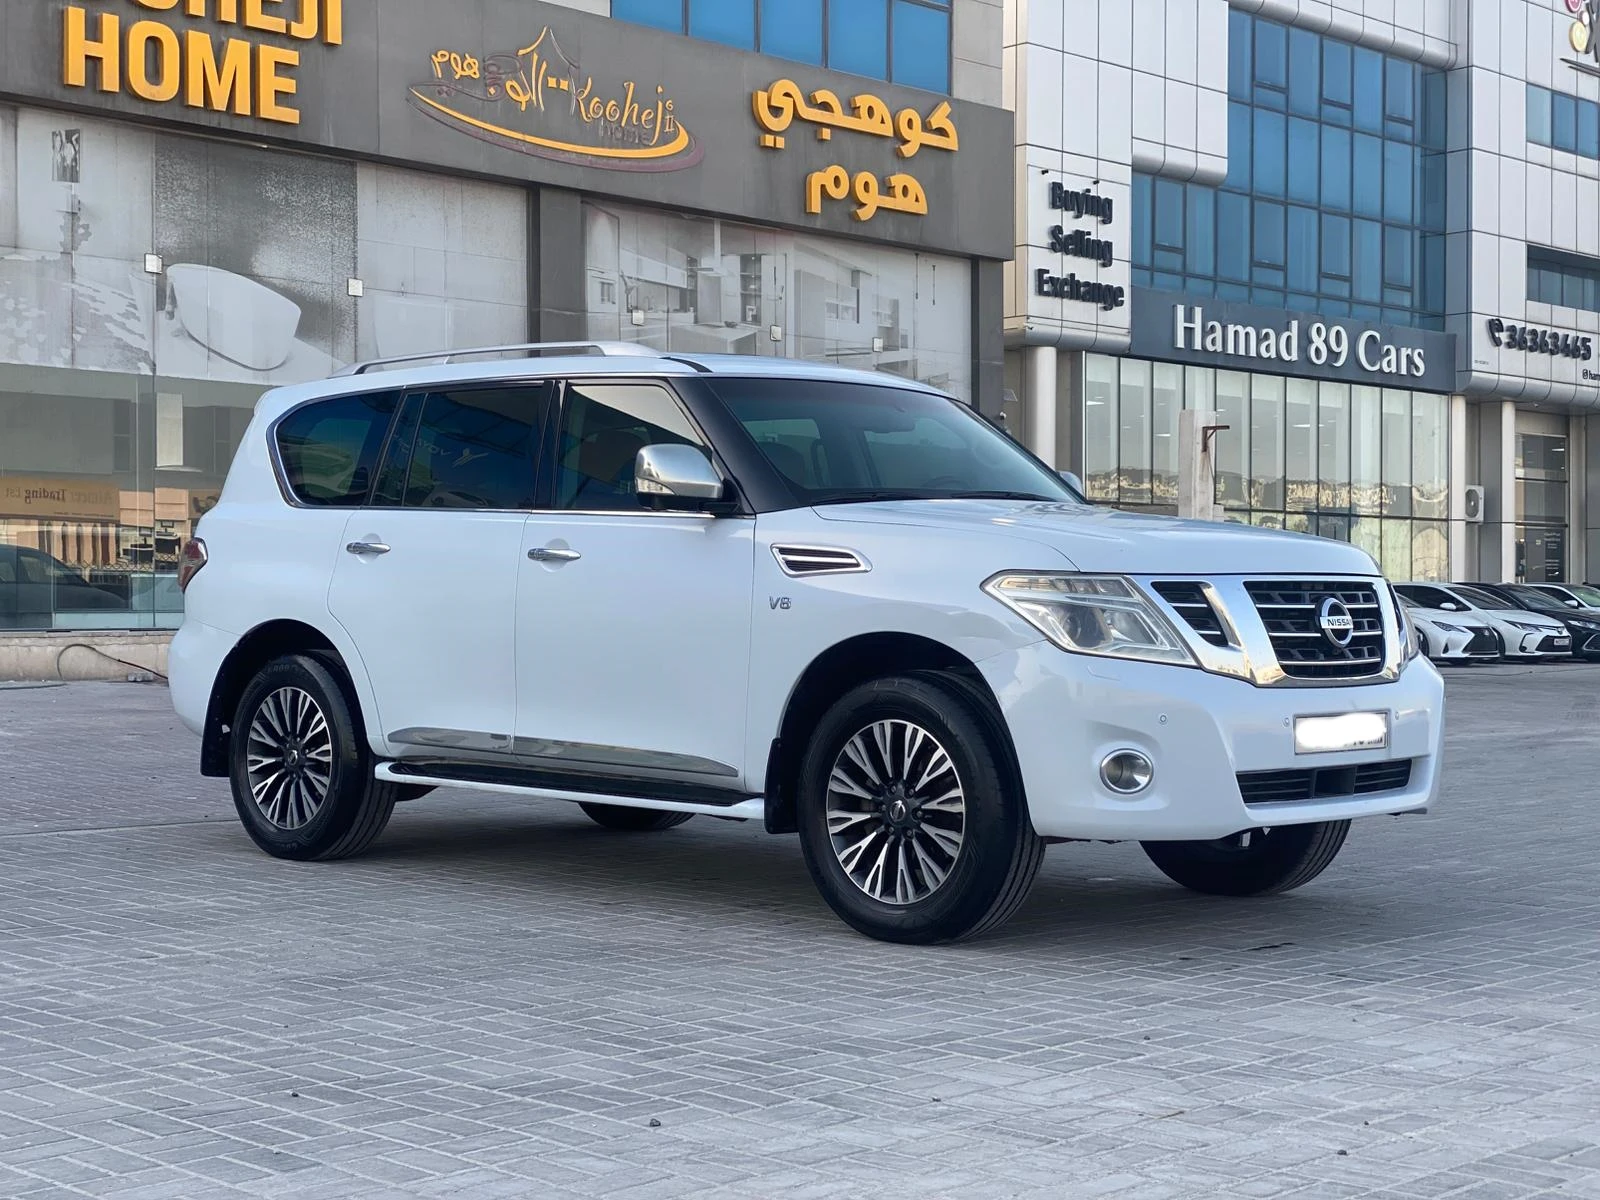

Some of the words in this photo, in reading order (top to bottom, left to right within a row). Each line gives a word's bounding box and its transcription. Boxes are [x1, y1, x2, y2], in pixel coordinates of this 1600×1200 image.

[63, 6, 300, 125] HOME
[752, 79, 959, 158] كوهجي
[806, 165, 928, 221] هوم
[1050, 181, 1113, 225] Buying
[1050, 225, 1113, 267] Selling
[1035, 268, 1125, 311] Exchange
[1173, 303, 1299, 362] Hamad
[1308, 322, 1348, 367] 89
[1355, 330, 1425, 377] Cars
[769, 596, 792, 610] V8
[1327, 618, 1352, 627] NISSA
